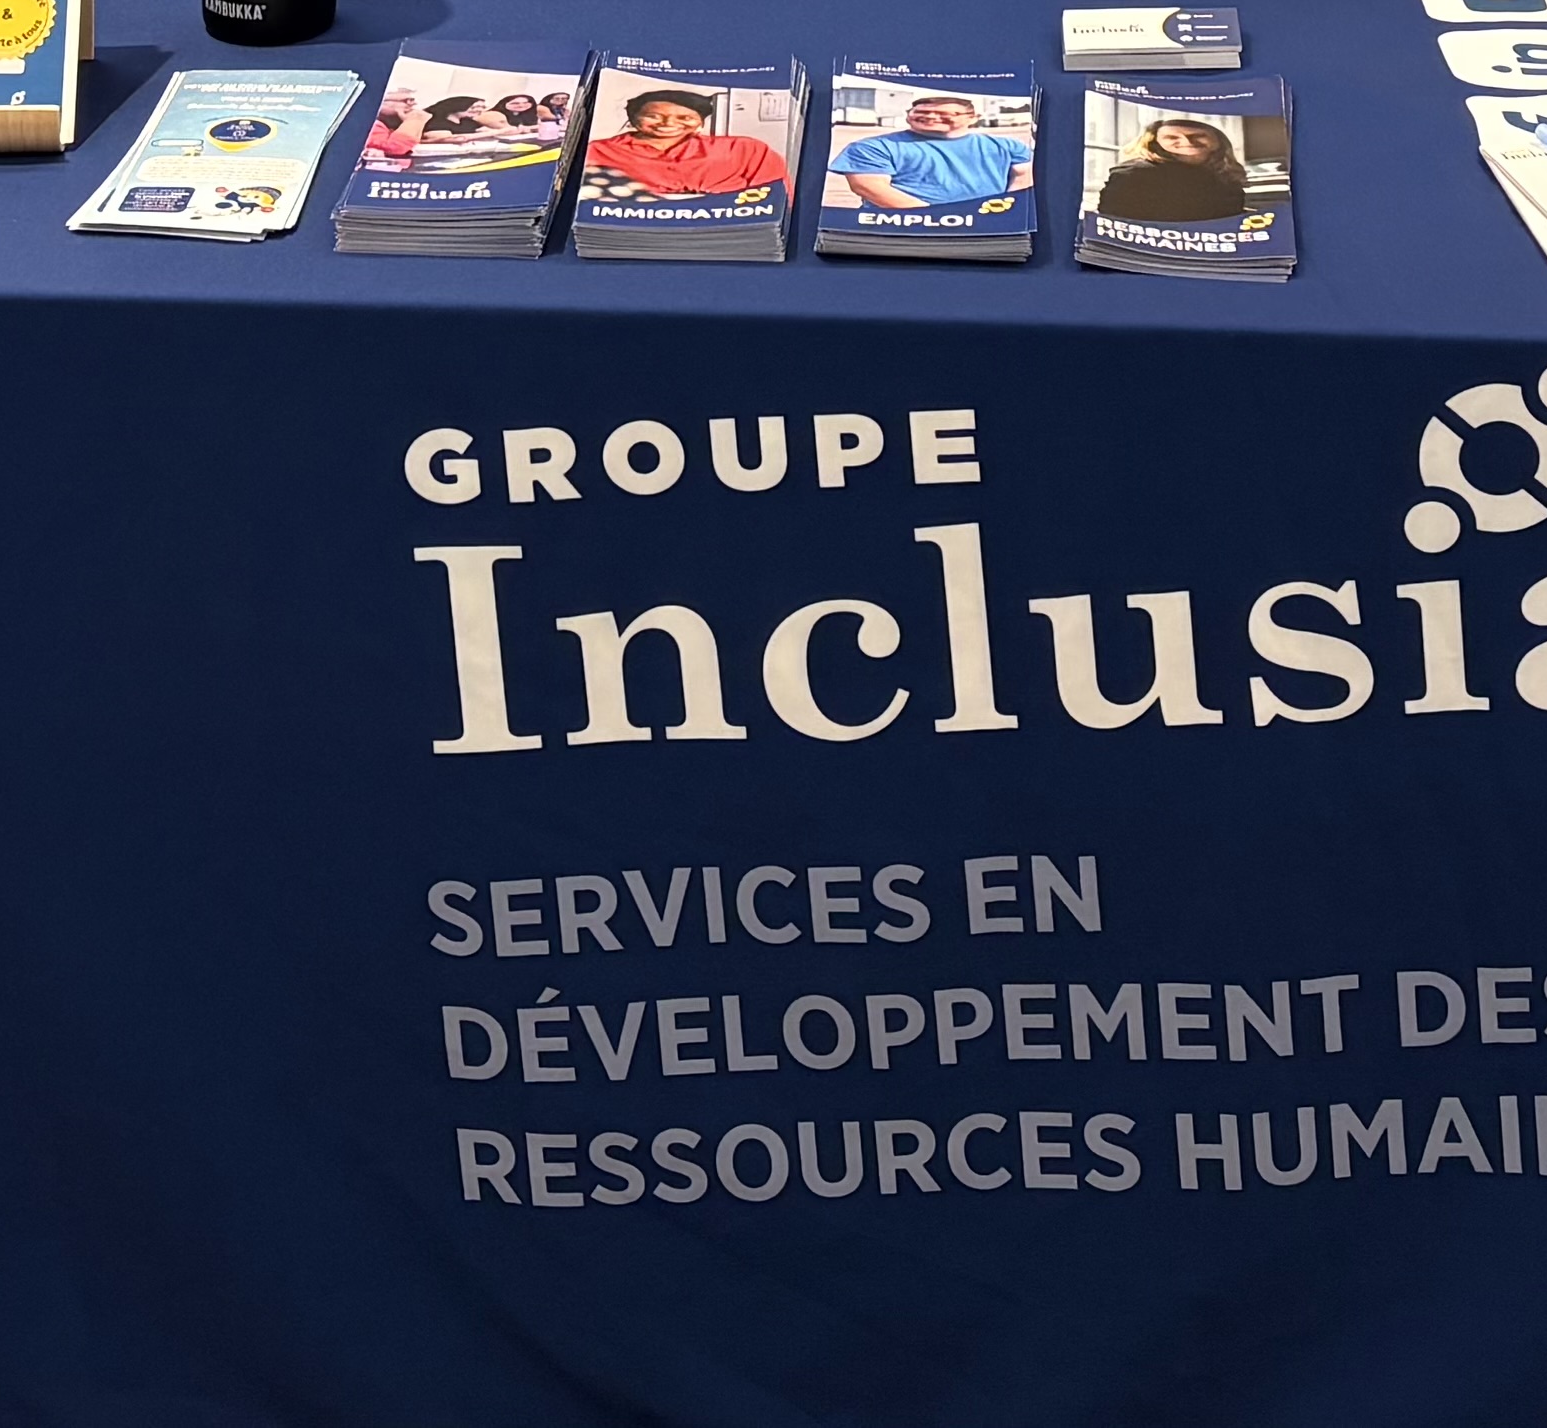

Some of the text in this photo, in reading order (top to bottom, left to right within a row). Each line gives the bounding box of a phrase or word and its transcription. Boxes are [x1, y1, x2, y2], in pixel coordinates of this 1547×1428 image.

[1, 7, 13, 20] &
[367, 182, 491, 200] Inclusia
[592, 203, 774, 221] IMMIGRATION
[857, 212, 974, 228] EMPLOI
[1095, 215, 1271, 242] RESSOURCES
[1096, 228, 1238, 254] HUMAINES
[404, 407, 982, 505] GROUPE
[426, 854, 1103, 958] SERVICES EN
[441, 973, 1360, 1084] DÉVELOPPEMENT
[455, 1110, 1141, 1209] RESSOURCES
